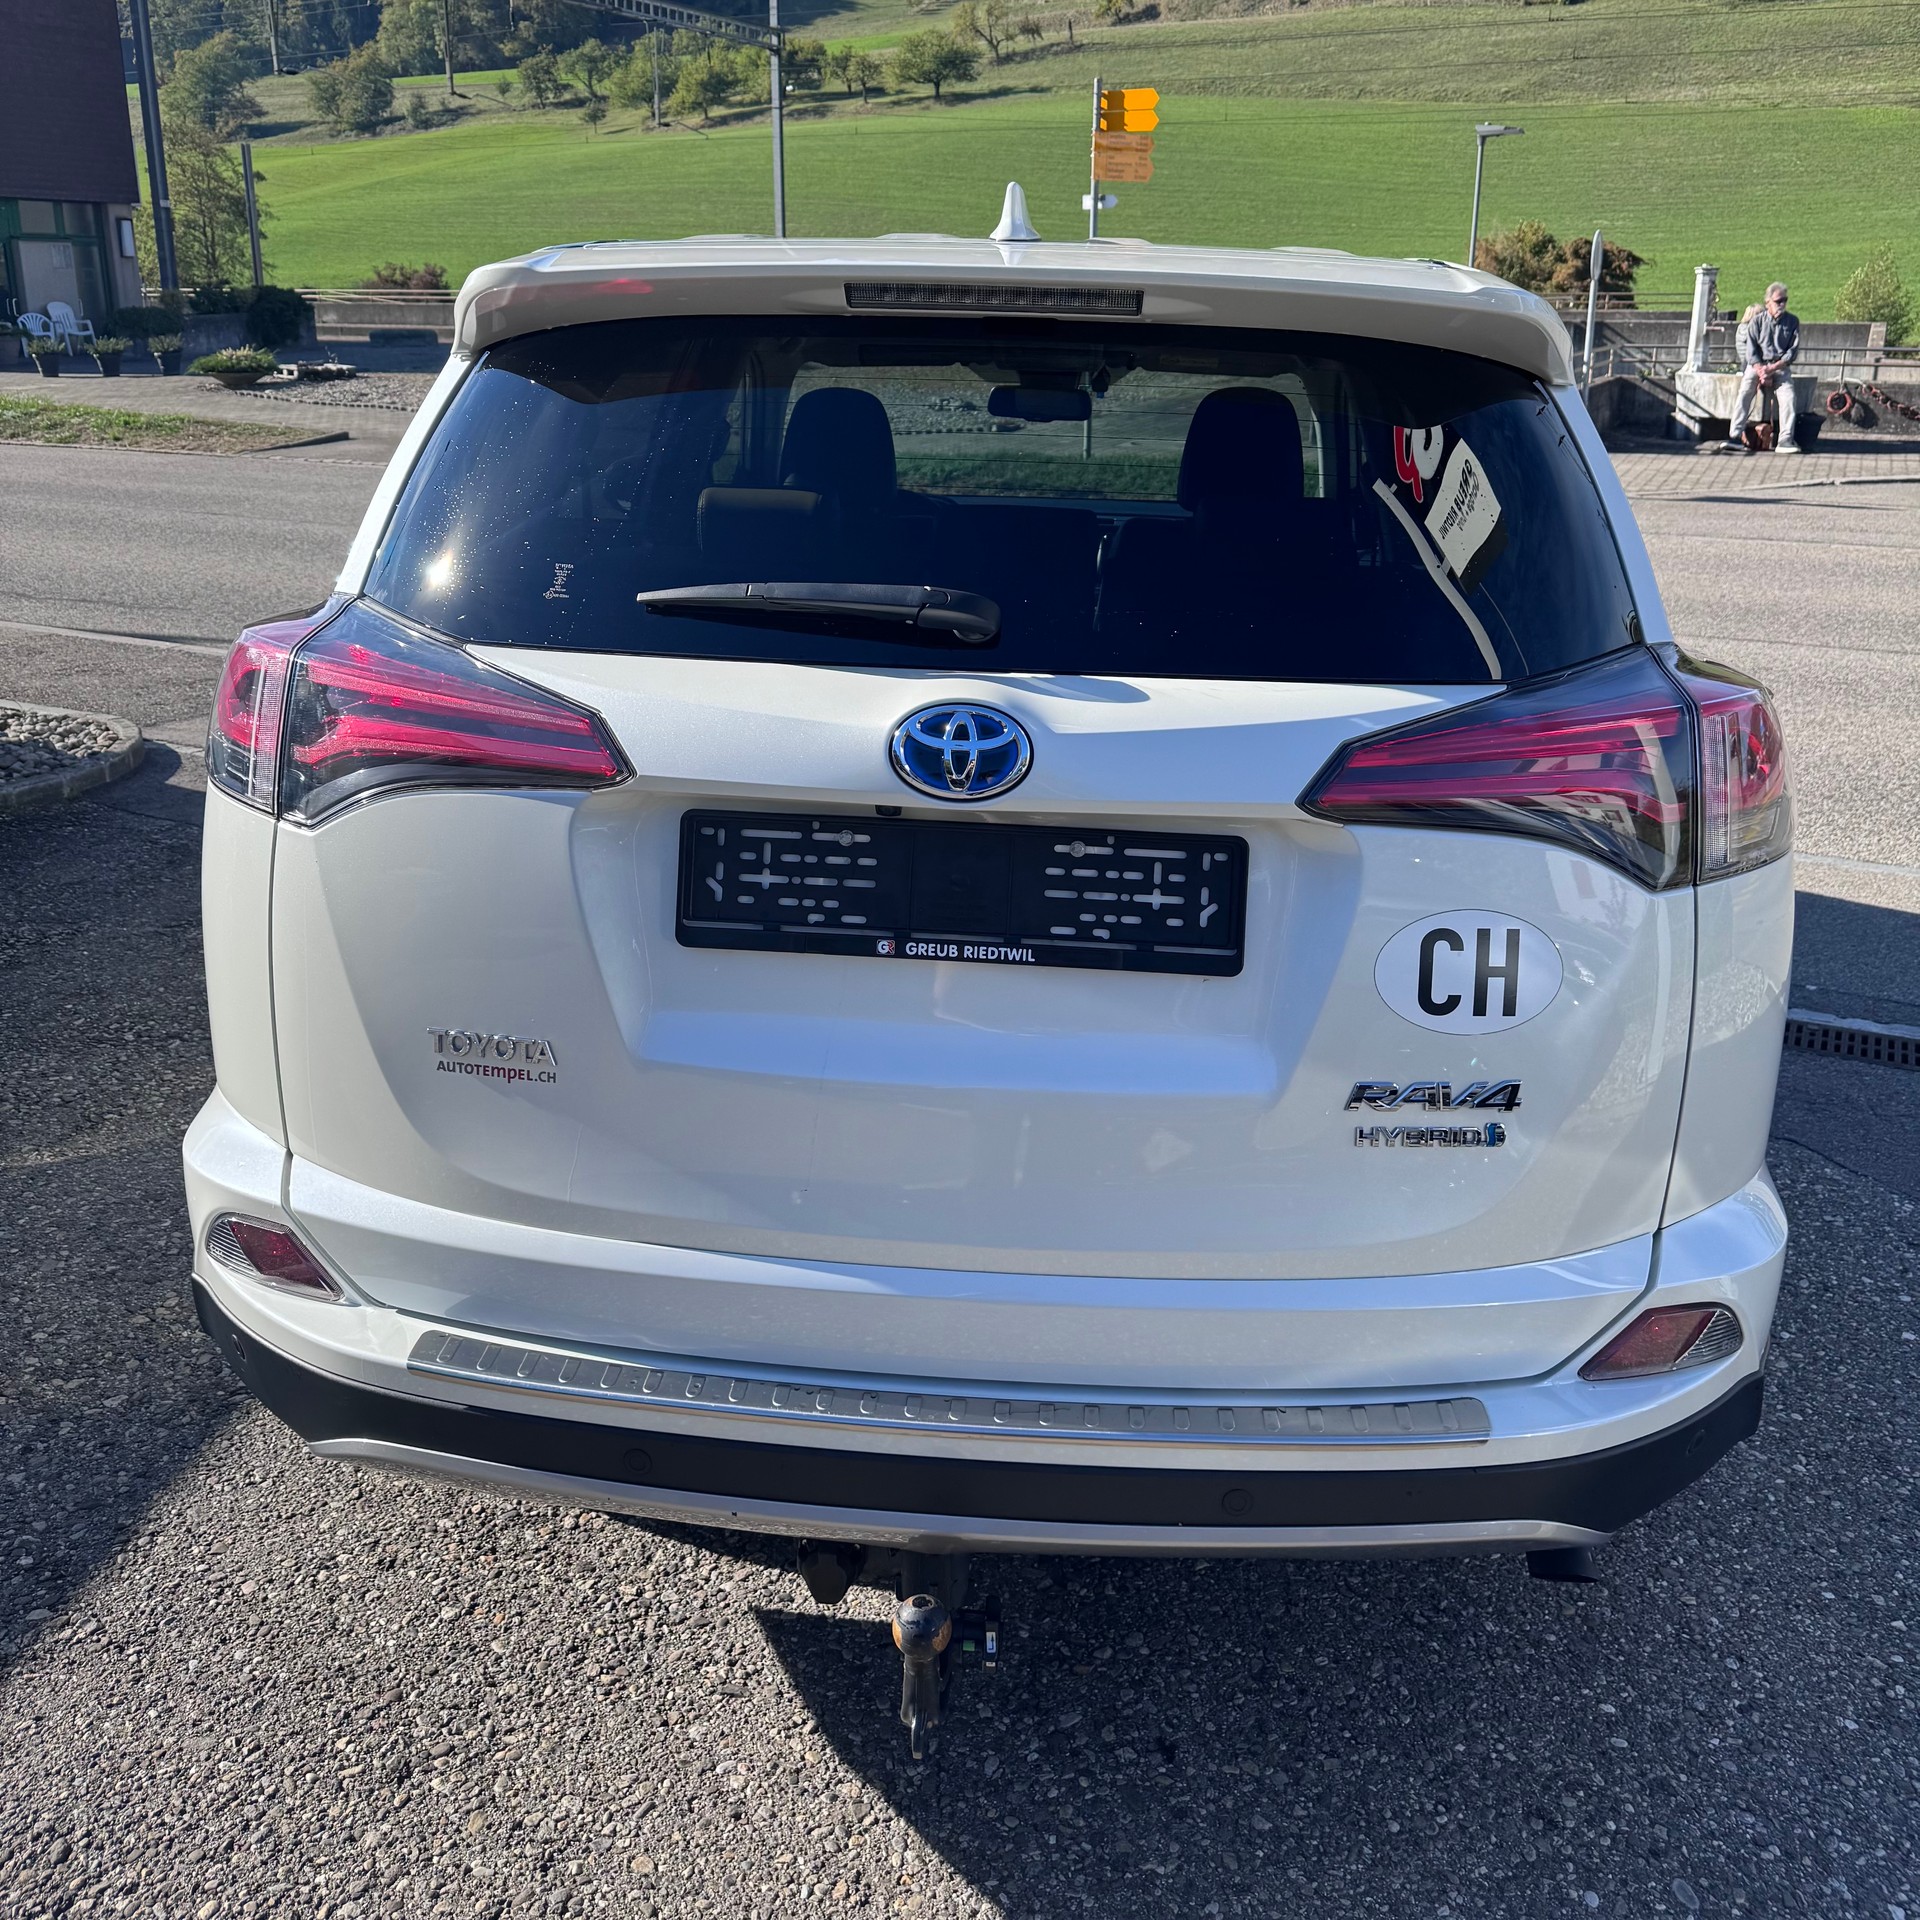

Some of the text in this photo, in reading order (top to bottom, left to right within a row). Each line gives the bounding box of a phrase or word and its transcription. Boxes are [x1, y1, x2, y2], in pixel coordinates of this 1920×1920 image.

[905, 942, 959, 958] GREUB
[963, 945, 1036, 962] RIEDTWIL
[1417, 927, 1521, 1017] CH
[426, 1027, 558, 1067] TOYOTA
[1344, 1079, 1523, 1113] RAV4
[1354, 1125, 1483, 1148] HYBRID
